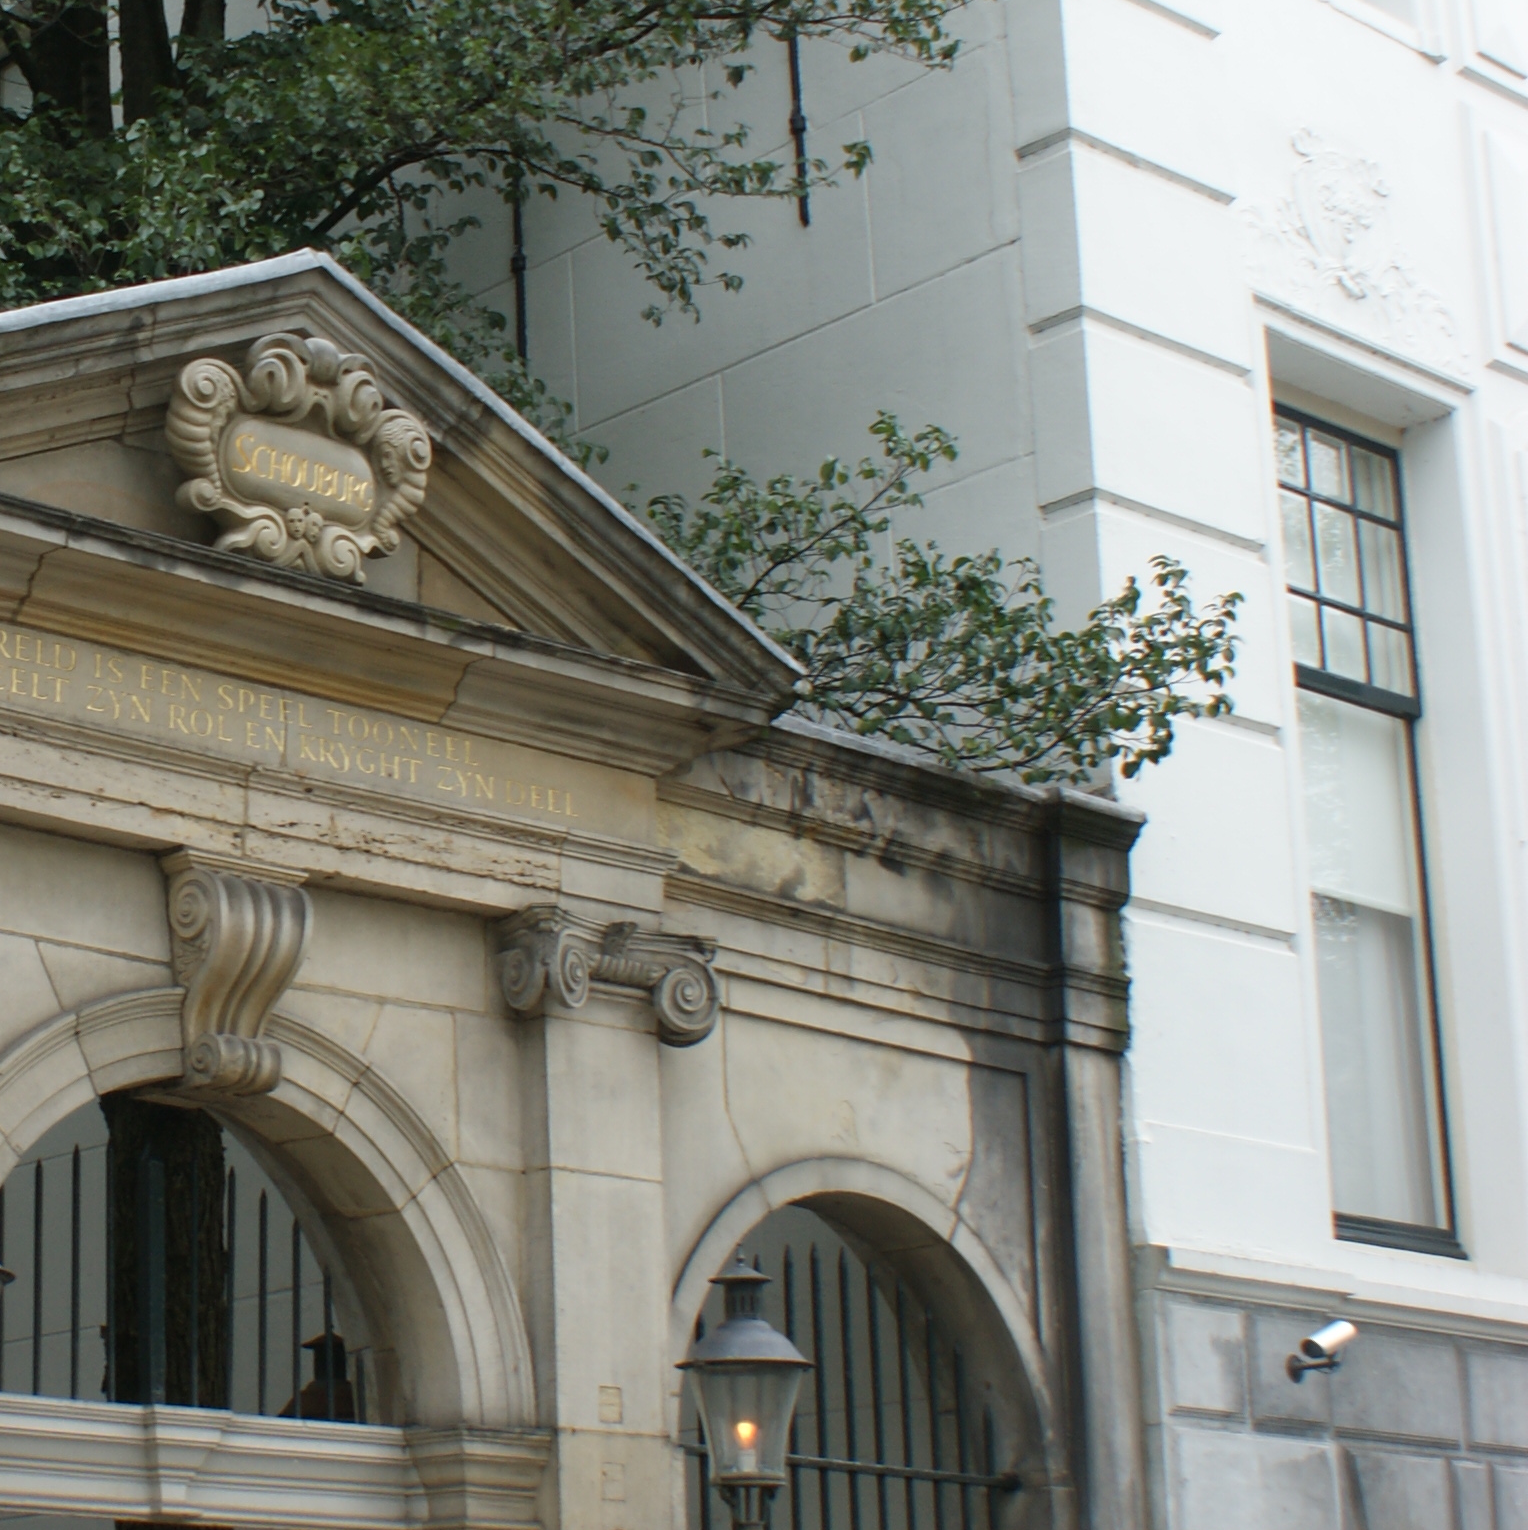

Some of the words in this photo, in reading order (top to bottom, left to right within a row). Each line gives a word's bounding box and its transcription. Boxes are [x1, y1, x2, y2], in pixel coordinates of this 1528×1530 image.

[232, 433, 373, 512] SCHOUBURG
[85, 684, 151, 724] ZYN
[168, 703, 233, 742] ROL
[245, 720, 286, 754] EN
[299, 733, 422, 784] KRYGHT
[436, 765, 496, 799] ZYN
[505, 779, 579, 817] DEEL
[94, 653, 123, 684] IS
[139, 664, 202, 703] EEN
[217, 683, 313, 729] SPEEL
[326, 708, 479, 767] TOONEEL
